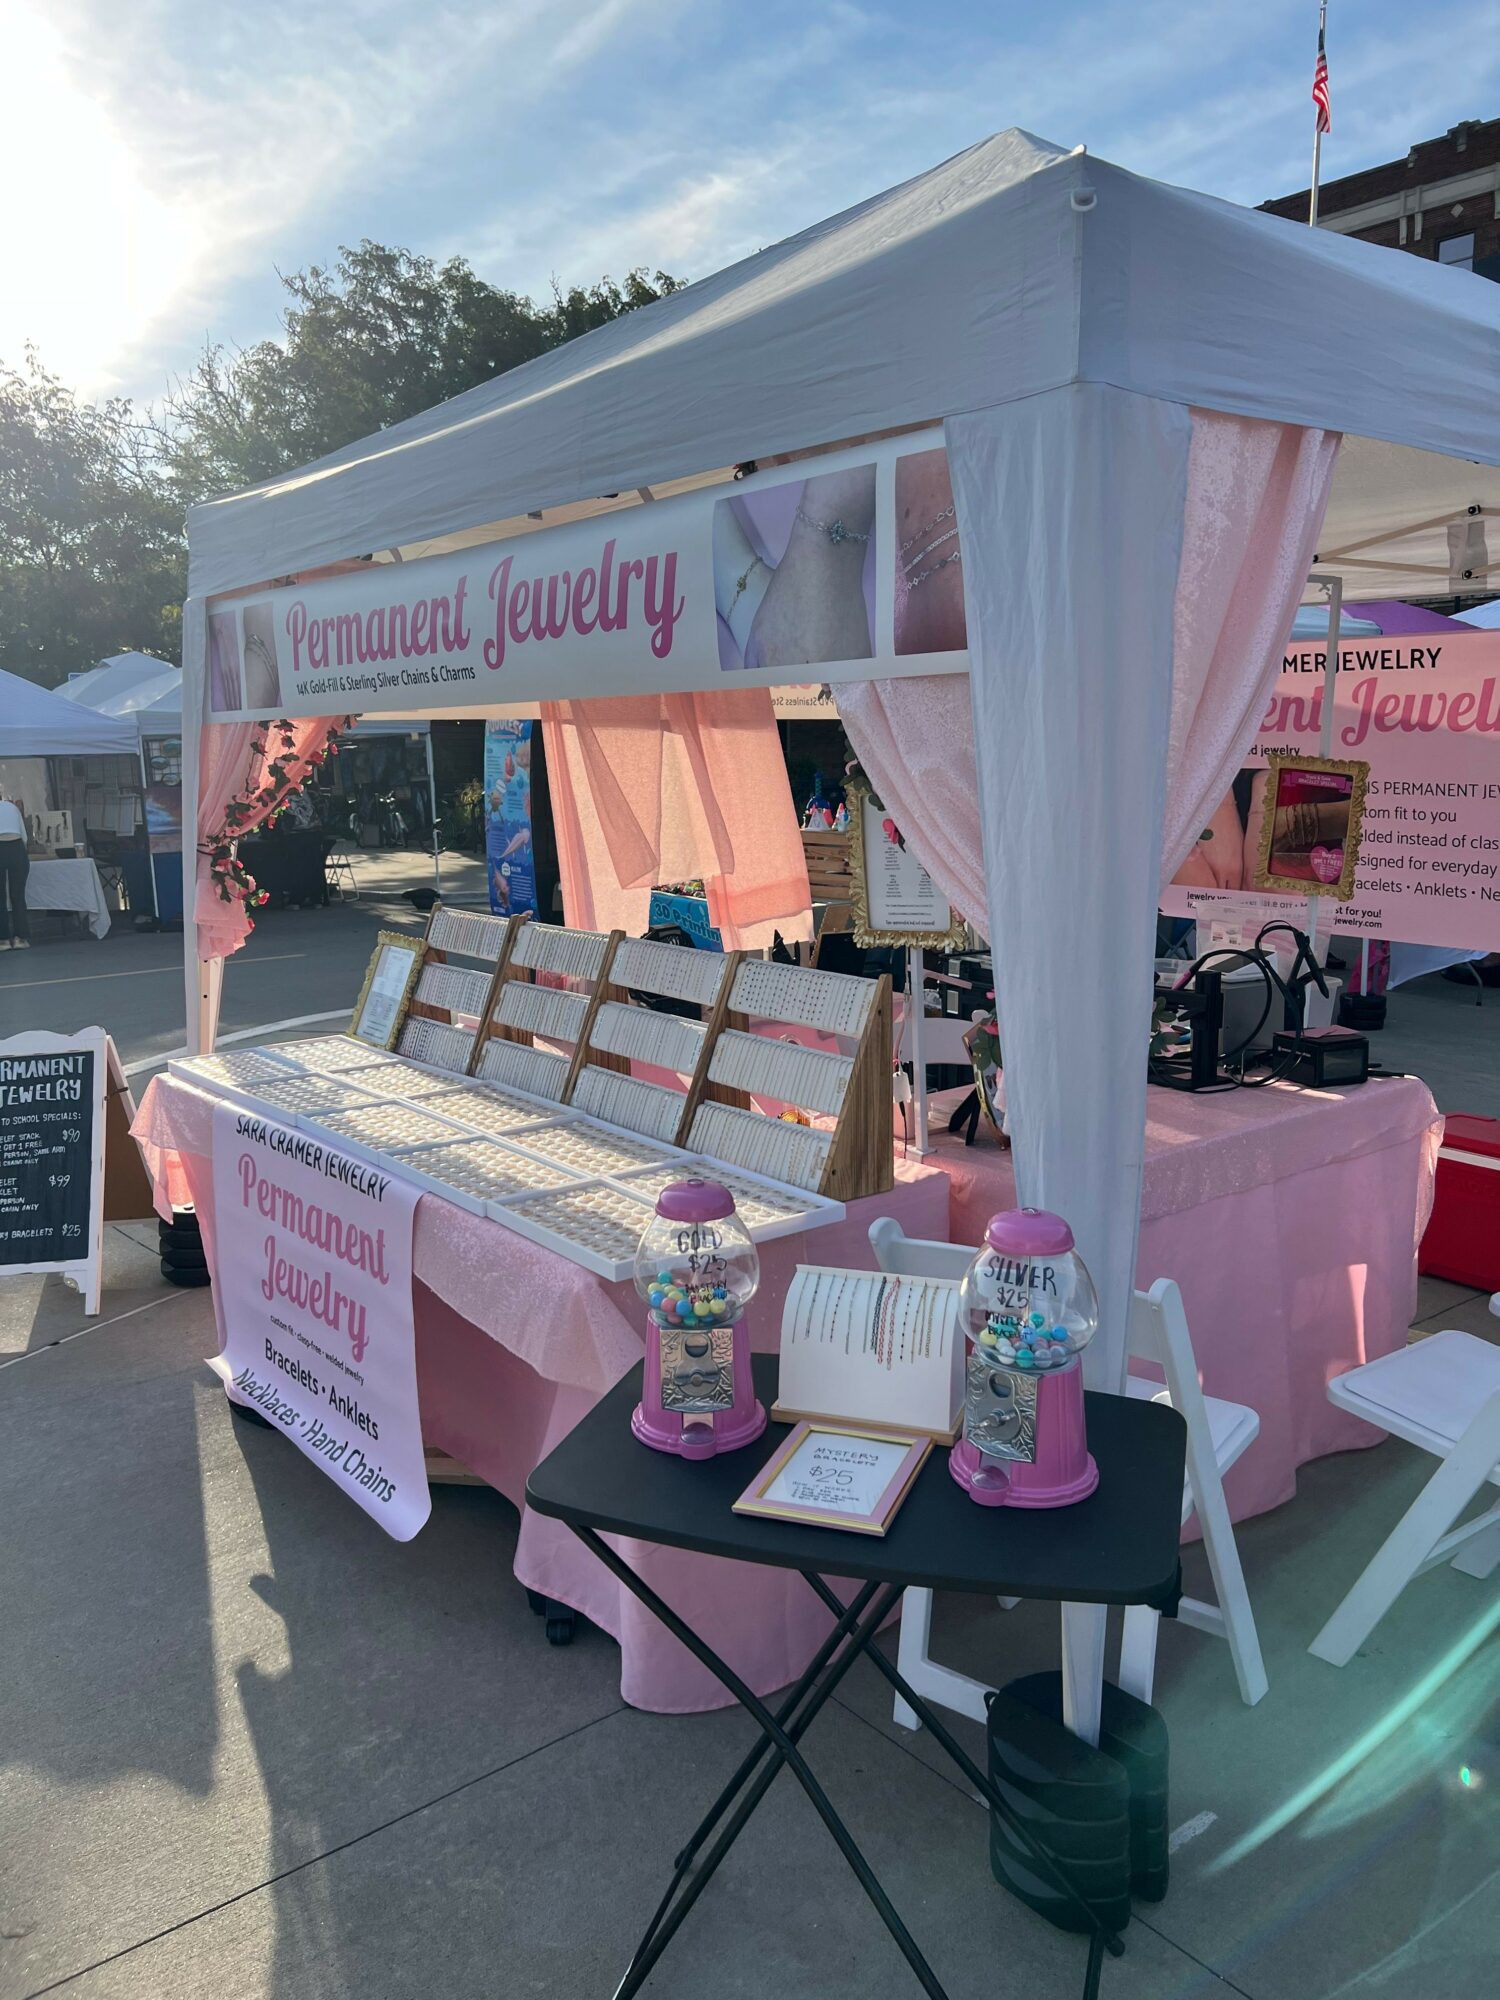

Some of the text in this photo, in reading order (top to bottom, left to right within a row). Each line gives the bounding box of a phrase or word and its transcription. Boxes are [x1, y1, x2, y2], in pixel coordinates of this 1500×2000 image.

[285, 539, 685, 671] Permanent Jewelry
[1279, 647, 1442, 674] MER JEWELRY
[296, 665, 476, 696] 14K Gold-Fill & Sterling Silver Chains & Charms
[1260, 744, 1300, 758] jewelry
[1384, 781, 1479, 797] PERMANENT
[1395, 805, 1408, 820] fit
[1412, 808, 1426, 821] to
[1430, 811, 1457, 825] you
[1397, 831, 1448, 848] instead
[1451, 834, 1467, 849] of
[1408, 856, 1428, 870] for
[1432, 860, 1497, 879] everyday
[1414, 882, 1467, 899] Anklets
[655, 902, 671, 920] 3D
[1345, 905, 1360, 916] for
[1361, 909, 1382, 919] you!
[1, 1111, 82, 1126] TO SCHOOL SPECIALS:
[18, 1132, 41, 1141] STACK
[62, 1128, 81, 1143] $90
[25, 1140, 43, 1149] FREE
[236, 1114, 391, 1203] SARA CRAMER JEWELRY
[48, 1174, 71, 1188] $99
[239, 1153, 390, 1286] Permanent
[11, 1228, 54, 1239] BRACELETS
[62, 1223, 81, 1237] $25
[677, 1229, 723, 1254] GOLD
[687, 1254, 727, 1275] $25
[984, 1255, 1057, 1296] SILVER
[262, 1235, 369, 1363] Jewelry
[996, 1287, 1030, 1309] $25
[270, 1315, 287, 1331] custom
[325, 1353, 343, 1371] welded
[344, 1363, 364, 1387] jewelry
[265, 1337, 378, 1440] Bracelets Anklets
[233, 1368, 396, 1503] Necklaces Hand Chains
[814, 1447, 879, 1461] MYSTERY
[809, 1465, 854, 1486] $25
